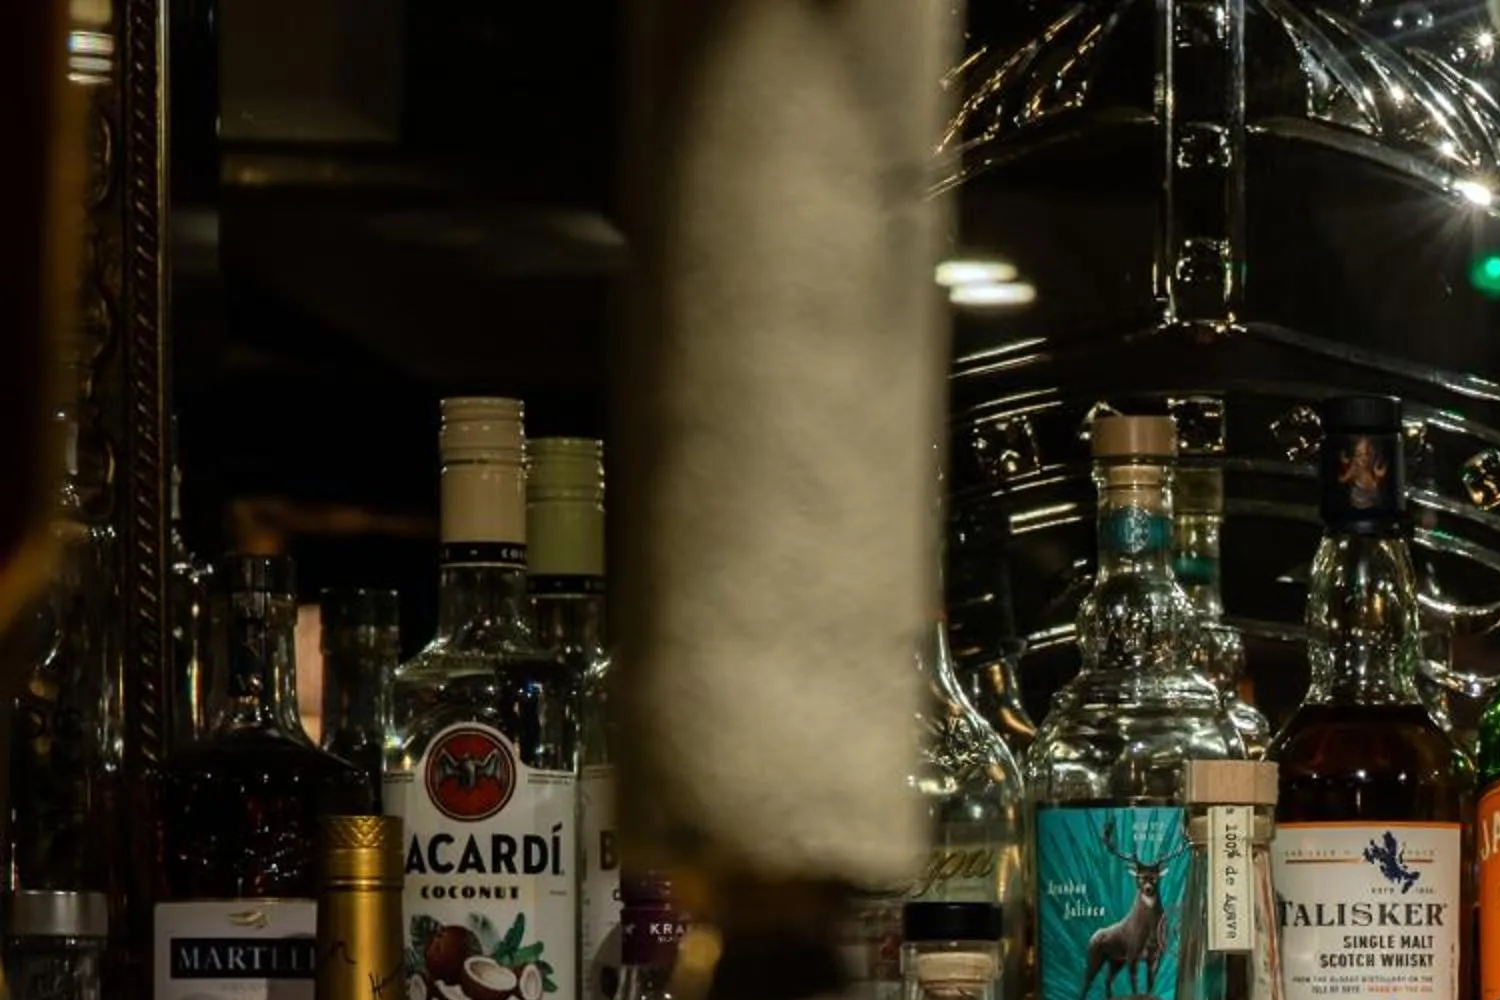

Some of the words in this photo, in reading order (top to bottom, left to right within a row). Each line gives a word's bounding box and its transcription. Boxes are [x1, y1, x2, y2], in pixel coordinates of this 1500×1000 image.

[404, 823, 563, 876] ACARDÍ
[1225, 866, 1239, 886] de
[420, 885, 519, 899] COCONUT
[1278, 902, 1444, 927] TALISKER
[1343, 935, 1396, 949] SINGLE
[1400, 935, 1434, 949] MALT
[1319, 954, 1376, 968] SCOTCH
[1381, 954, 1434, 968] WHISKY
